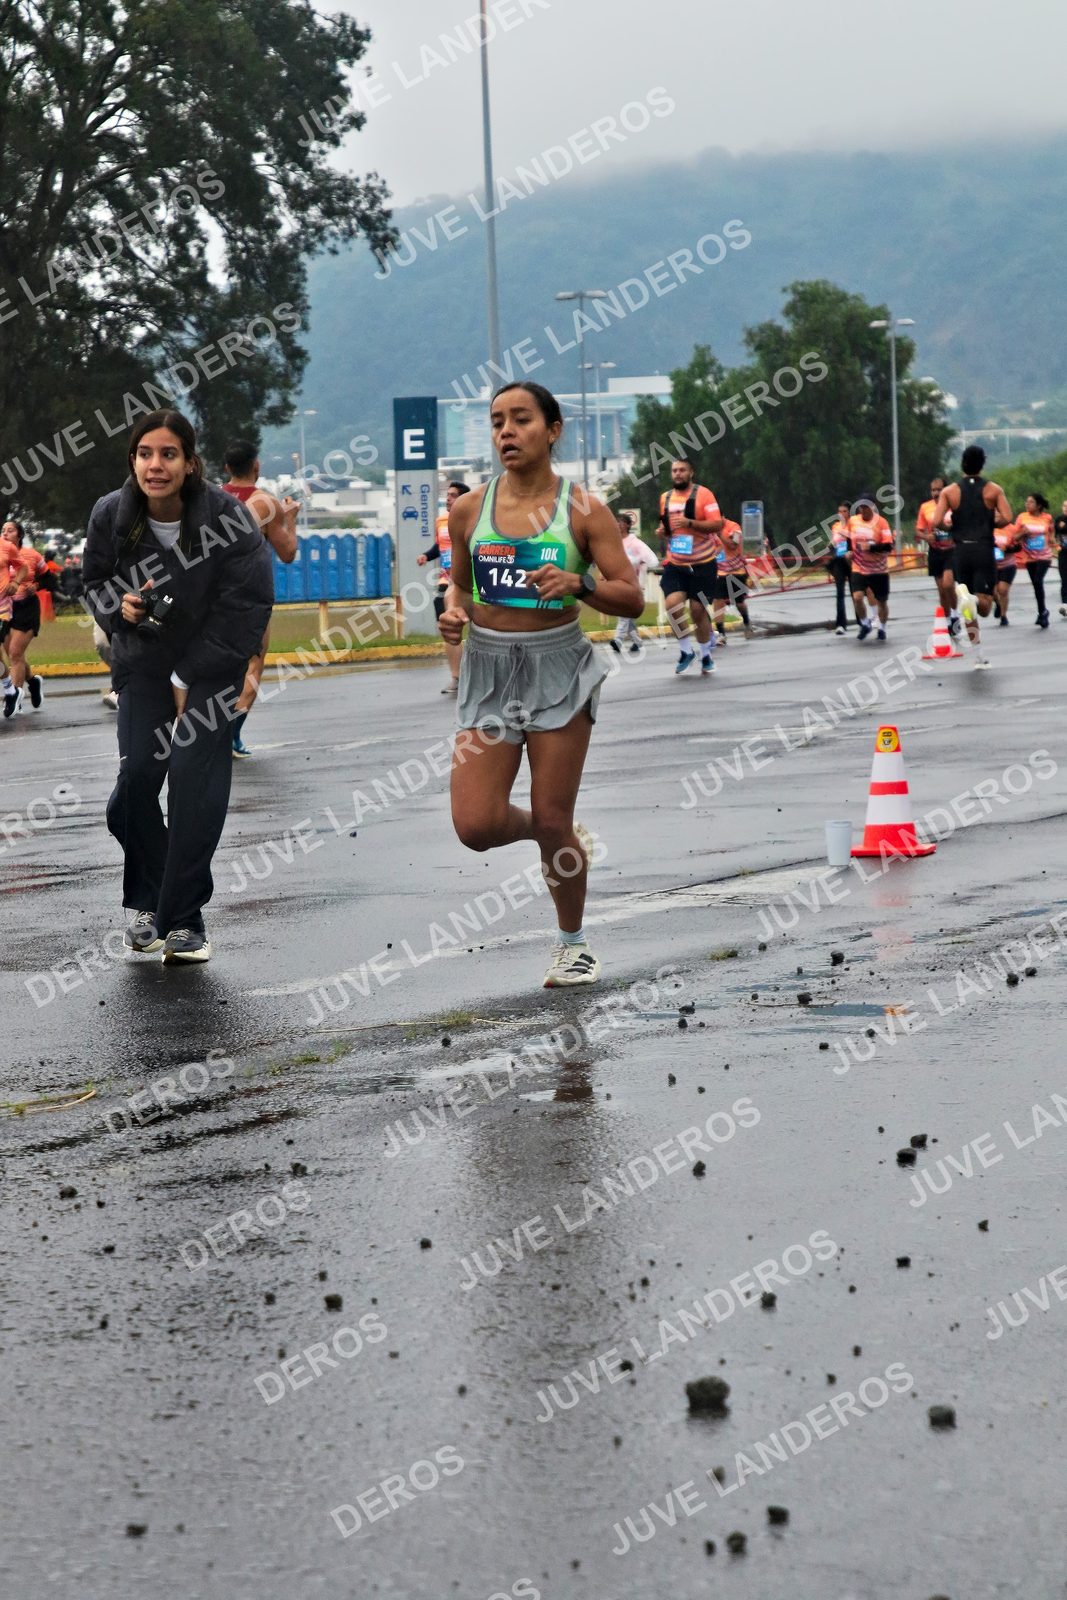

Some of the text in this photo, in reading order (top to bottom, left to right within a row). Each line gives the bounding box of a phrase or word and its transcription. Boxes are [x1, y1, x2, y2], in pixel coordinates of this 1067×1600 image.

[403, 428, 426, 460] E
[420, 484, 431, 537] General
[479, 545, 516, 555] CARRERA
[541, 548, 559, 561] 10K
[488, 567, 540, 589] 142
